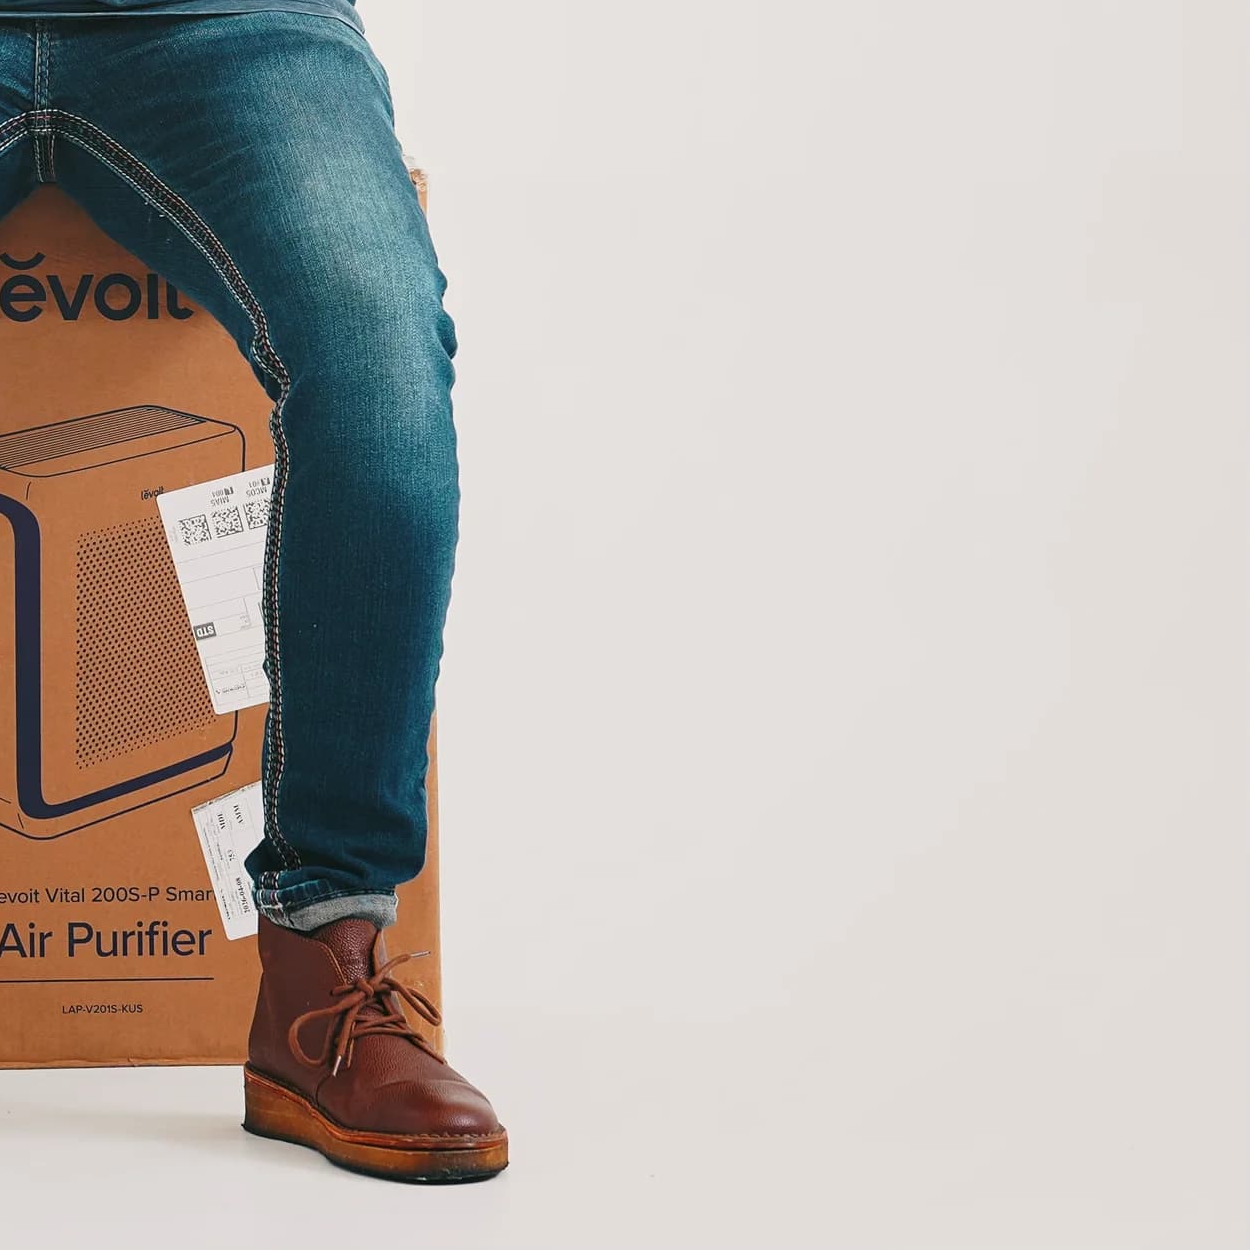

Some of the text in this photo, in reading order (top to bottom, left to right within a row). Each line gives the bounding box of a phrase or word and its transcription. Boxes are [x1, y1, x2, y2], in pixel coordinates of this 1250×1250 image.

[196, 625, 214, 637] STD
[46, 887, 85, 903] Vital
[92, 886, 160, 903] 200S-P
[166, 886, 216, 902] Smar
[67, 920, 213, 958] Purifier
[62, 1004, 144, 1015] LAP-V201S-KUS
